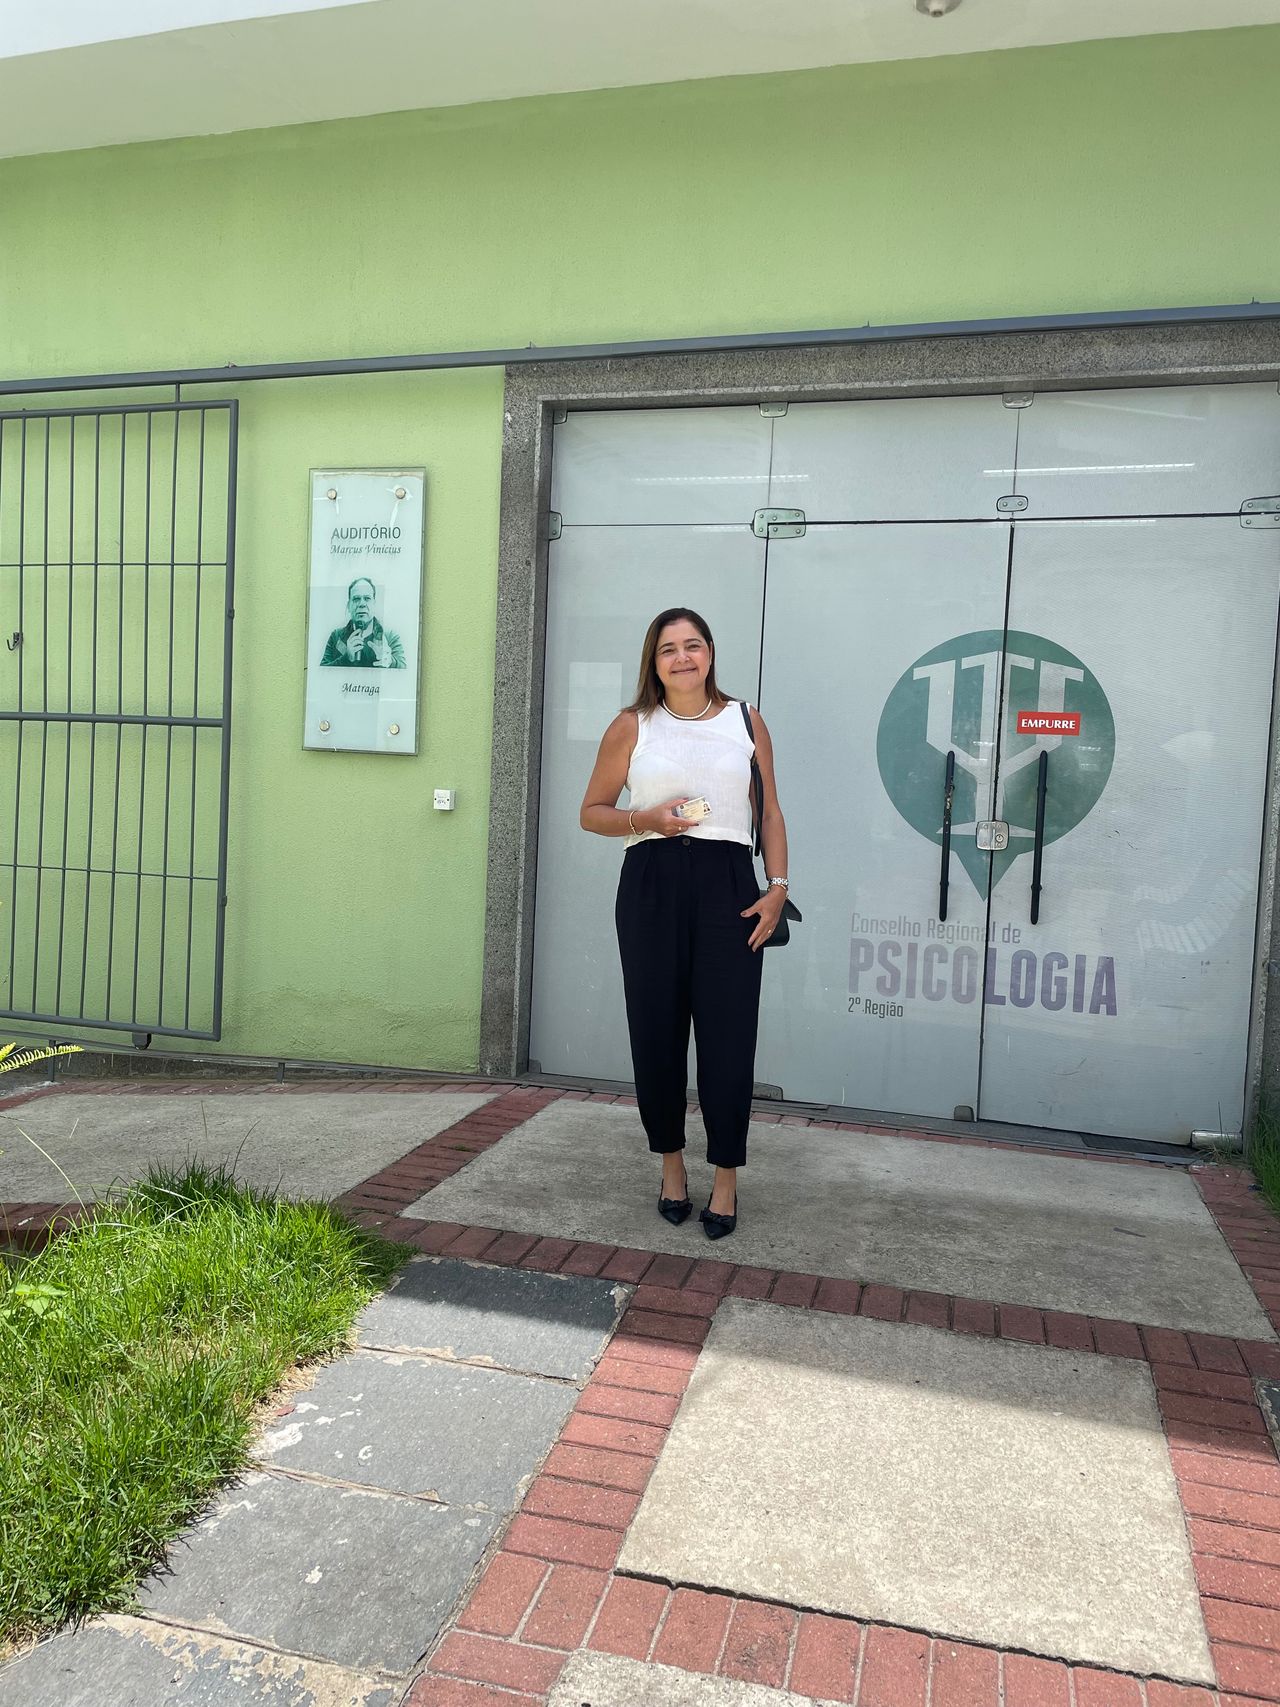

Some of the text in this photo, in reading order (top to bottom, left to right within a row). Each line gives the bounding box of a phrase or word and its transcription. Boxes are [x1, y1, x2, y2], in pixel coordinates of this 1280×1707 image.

[331, 523, 401, 539] AUDITÓRIO
[330, 544, 363, 554] Marcus
[342, 682, 380, 696] Matraga
[1021, 718, 1076, 730] EMPURRE
[851, 912, 921, 937] Conselho
[1002, 922, 1021, 944] de
[848, 938, 1117, 1017] PSICOLOGIA
[864, 998, 904, 1019] Região
